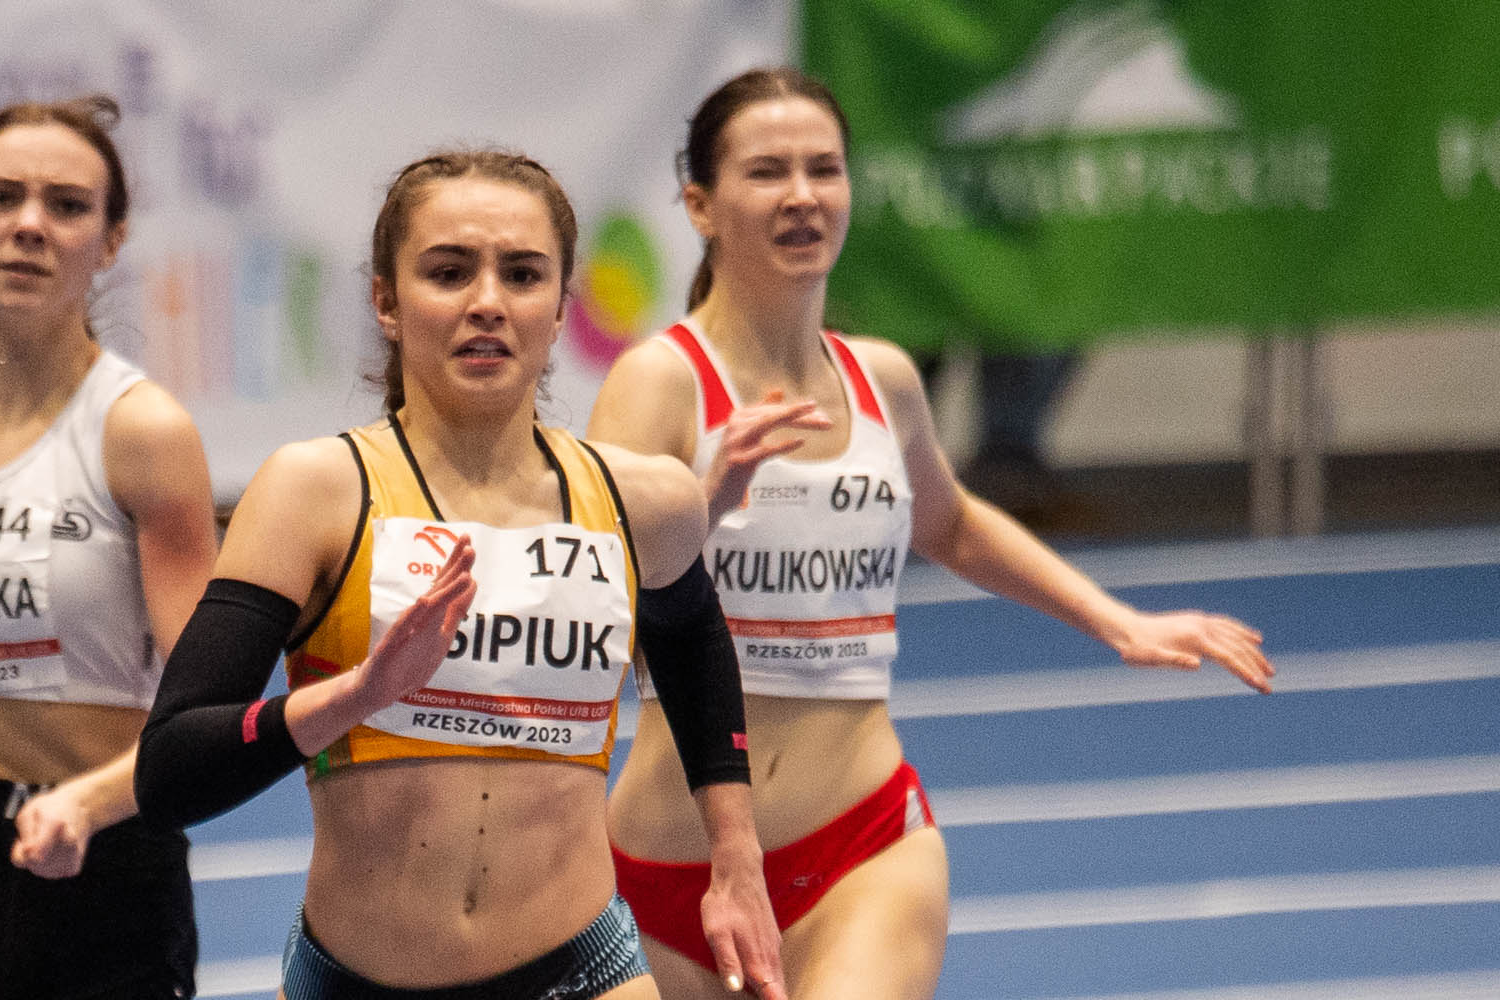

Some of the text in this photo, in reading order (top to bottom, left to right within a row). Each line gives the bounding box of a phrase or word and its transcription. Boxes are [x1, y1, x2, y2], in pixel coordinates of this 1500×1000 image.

[830, 475, 896, 513] 674
[525, 536, 611, 584] 171
[713, 547, 897, 593] KULIKOWSKA
[746, 642, 868, 660] RZESZÓW 2023
[412, 712, 572, 744] RZESZÓW 2023
